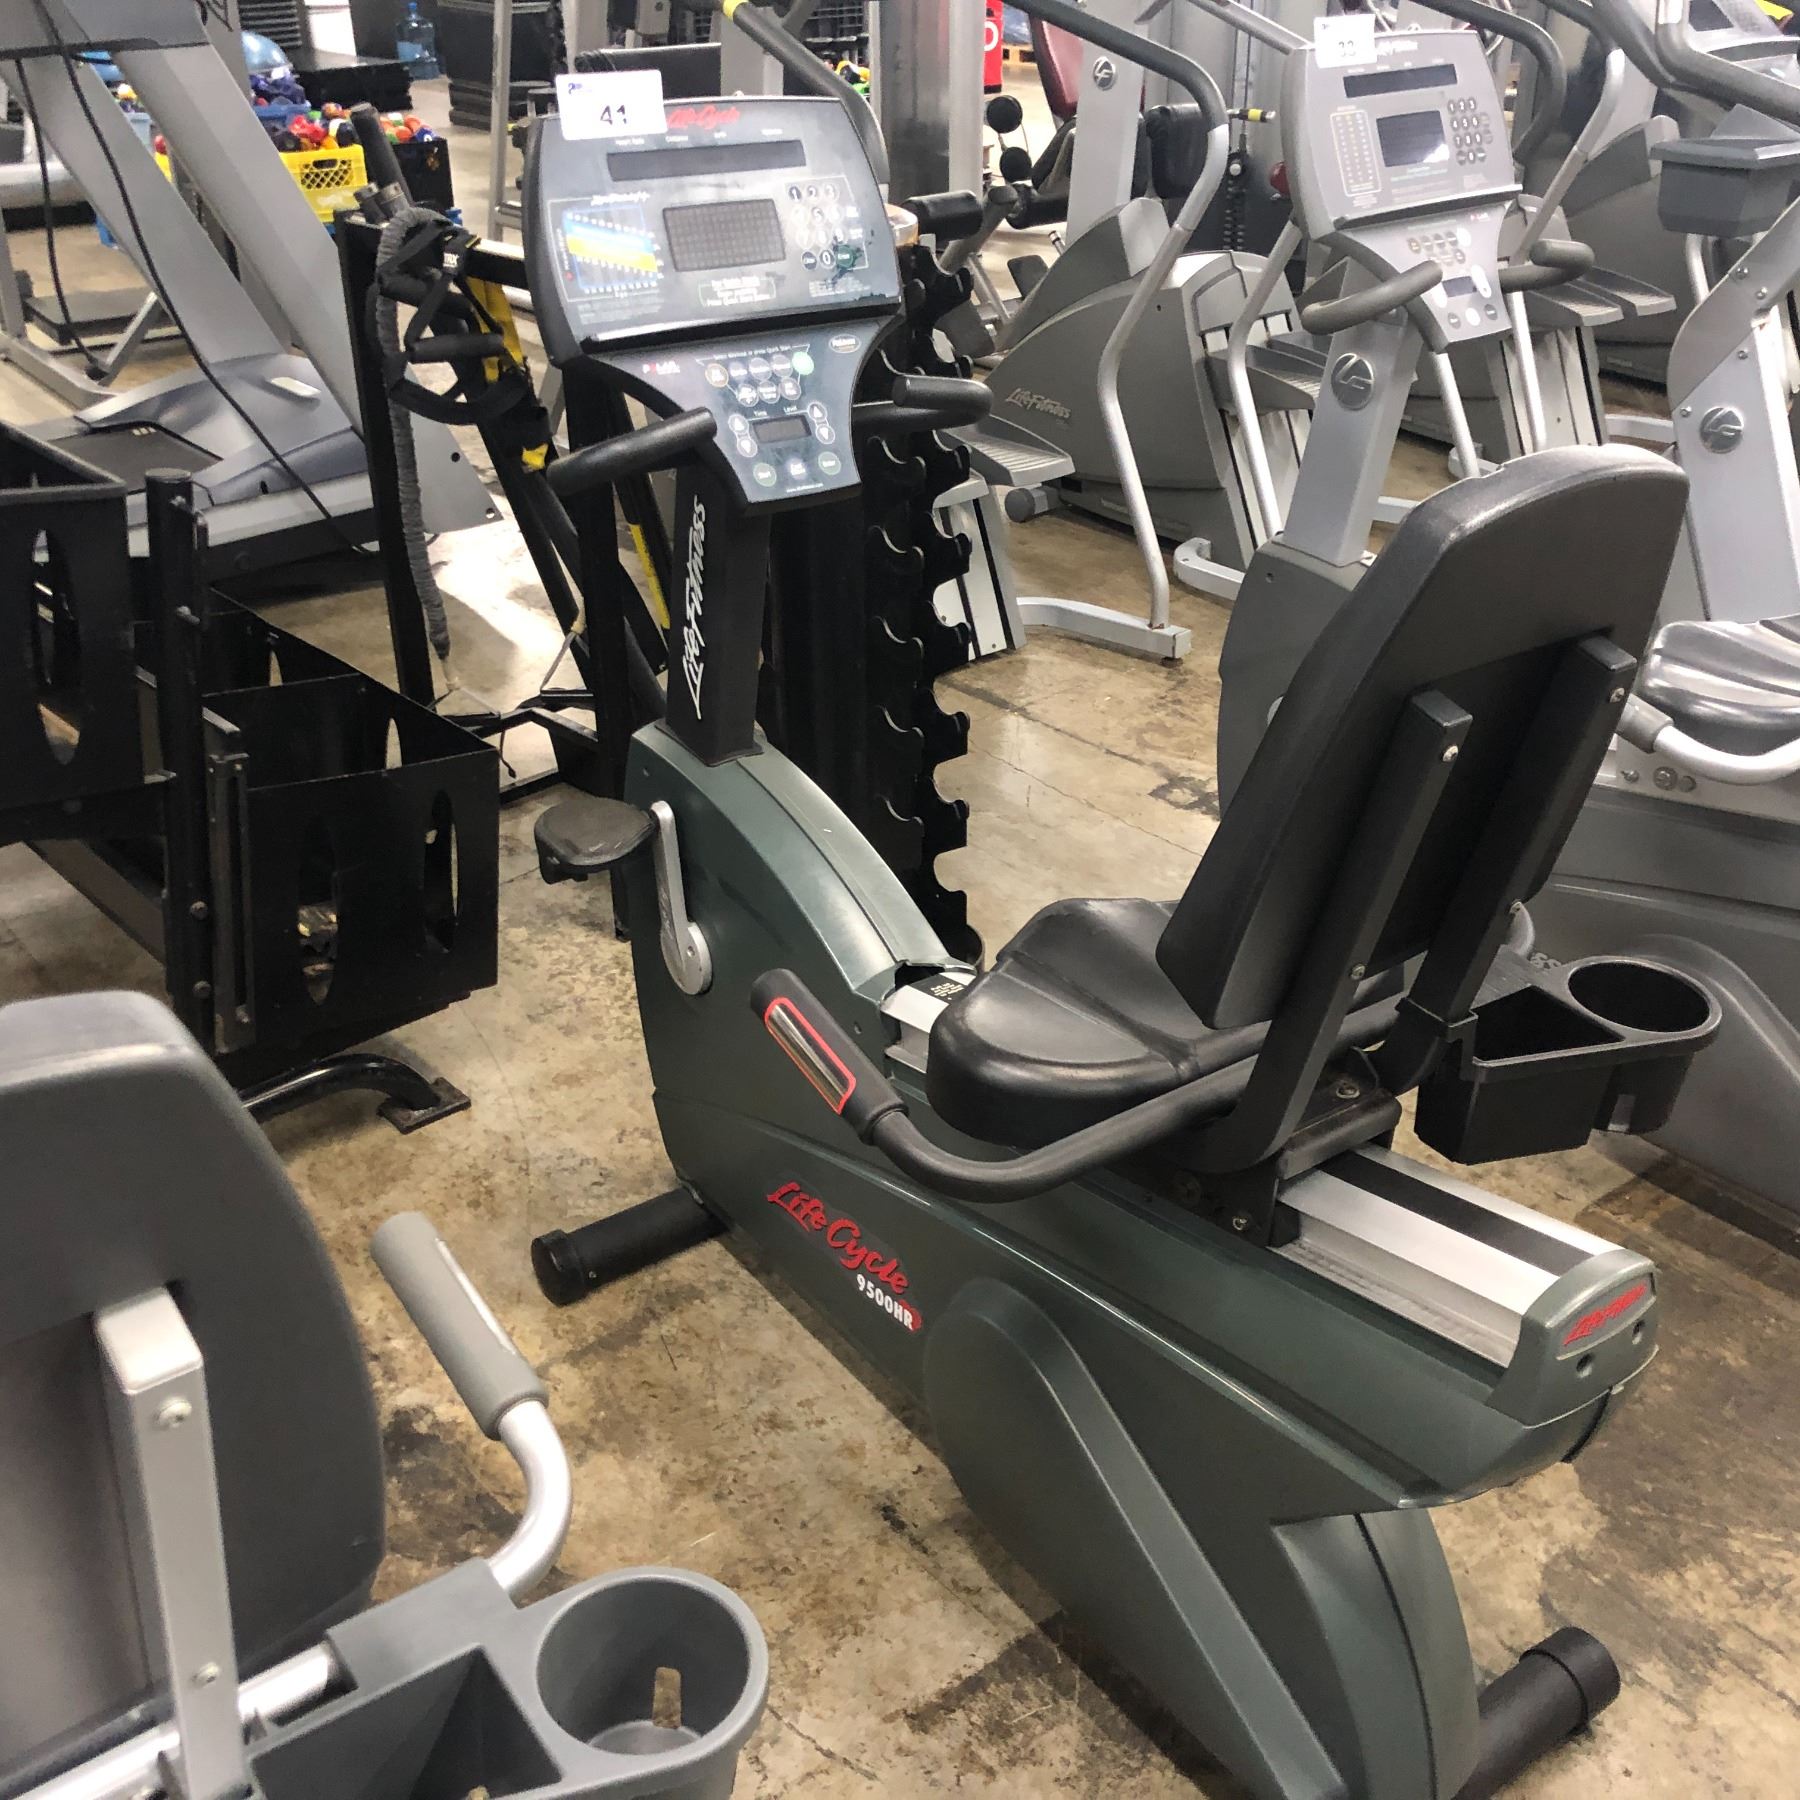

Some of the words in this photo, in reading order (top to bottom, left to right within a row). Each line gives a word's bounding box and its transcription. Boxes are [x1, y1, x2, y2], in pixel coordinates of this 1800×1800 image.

[767, 1181, 828, 1232] Life
[827, 1218, 909, 1294] Cycle
[856, 1273, 915, 1330] 9500HR
